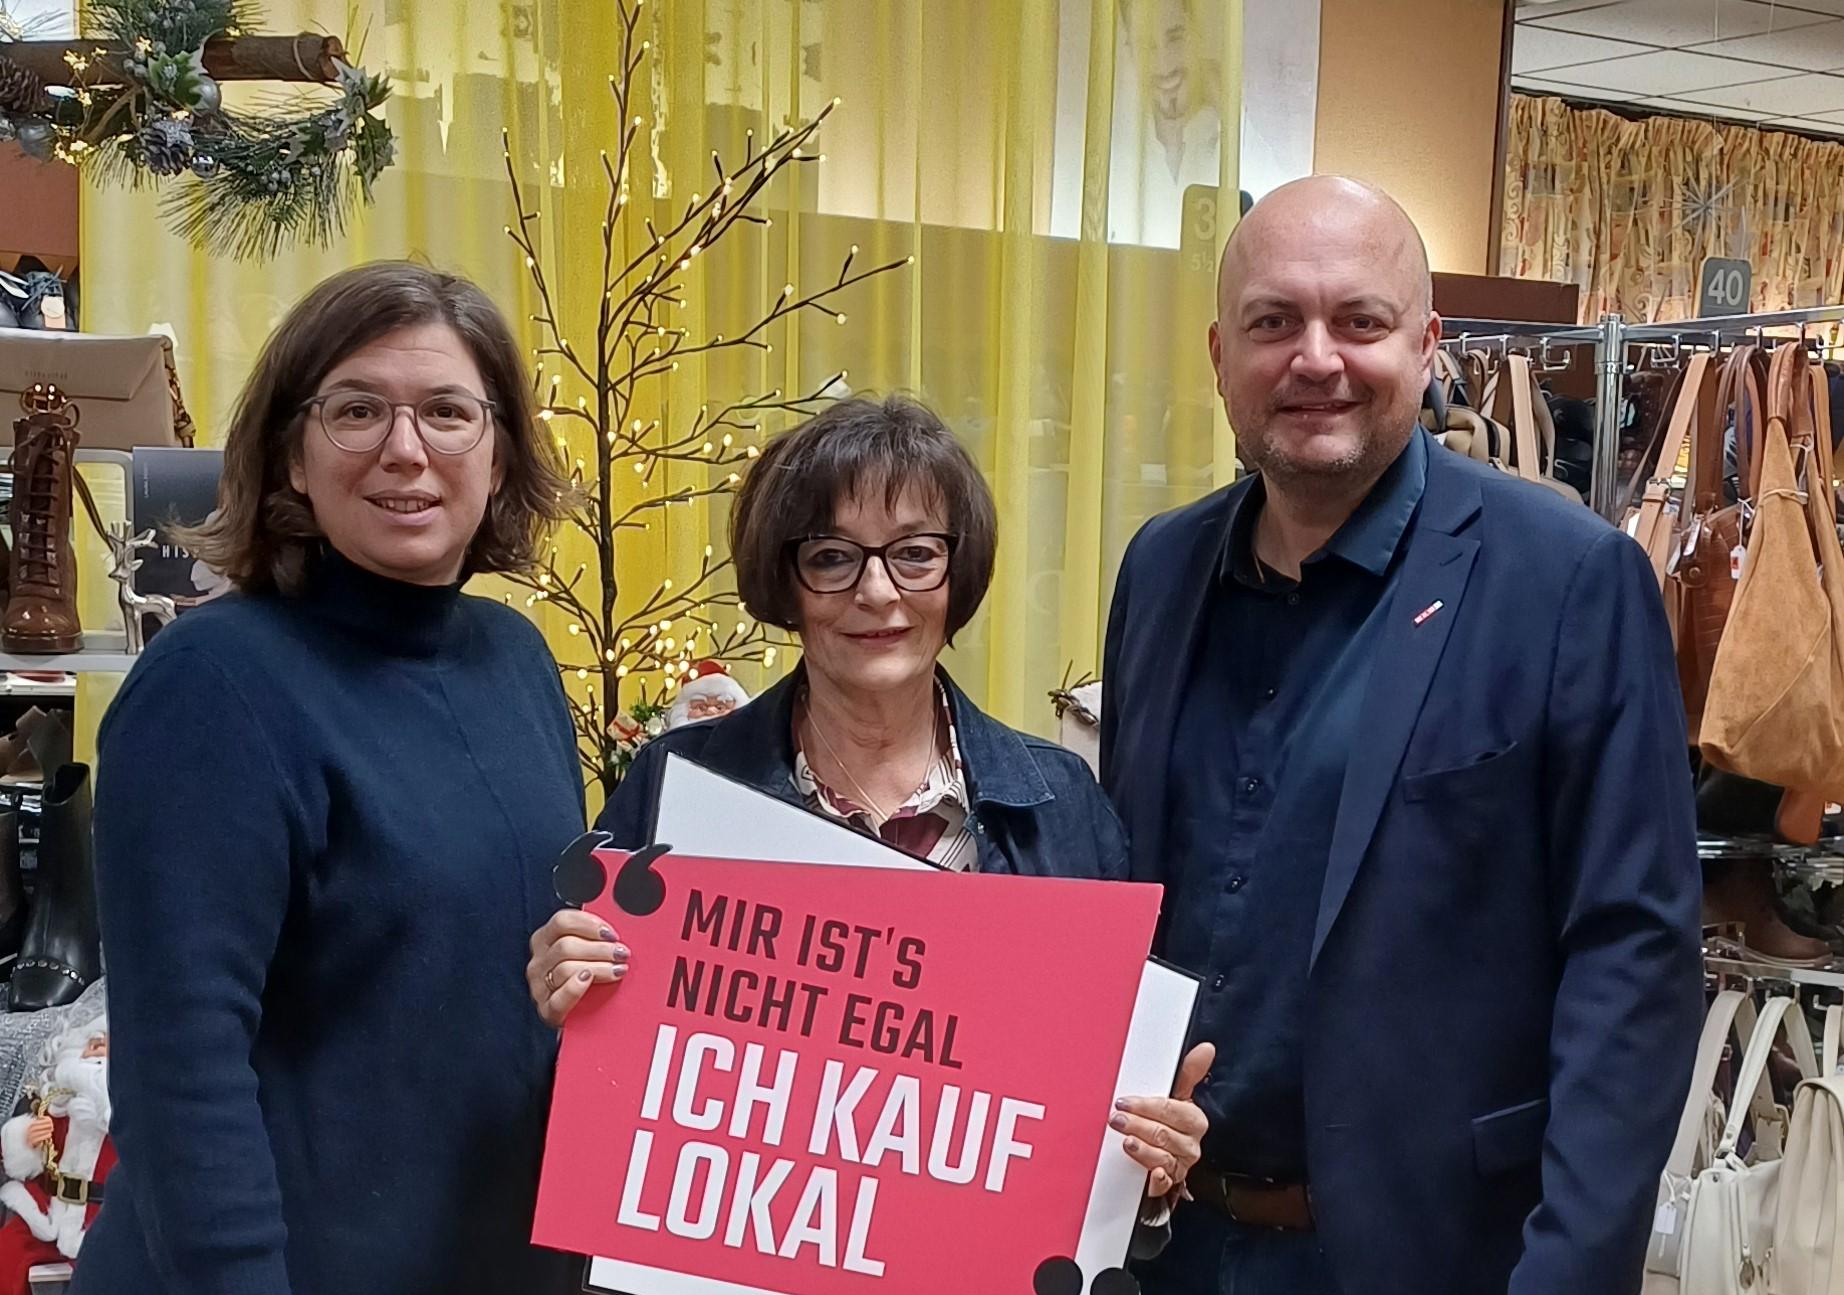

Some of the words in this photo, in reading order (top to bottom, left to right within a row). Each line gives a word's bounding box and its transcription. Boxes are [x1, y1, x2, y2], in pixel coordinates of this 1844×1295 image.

[1194, 198, 1216, 240] 3
[1708, 269, 1743, 306] 40
[680, 888, 784, 961] MIR
[796, 914, 927, 991] IST'S
[666, 956, 828, 1037] NICHT
[839, 995, 963, 1069] EGAL
[640, 1023, 799, 1147] ICH
[808, 1059, 1046, 1193] KAUF
[616, 1128, 887, 1277] LOKAL
